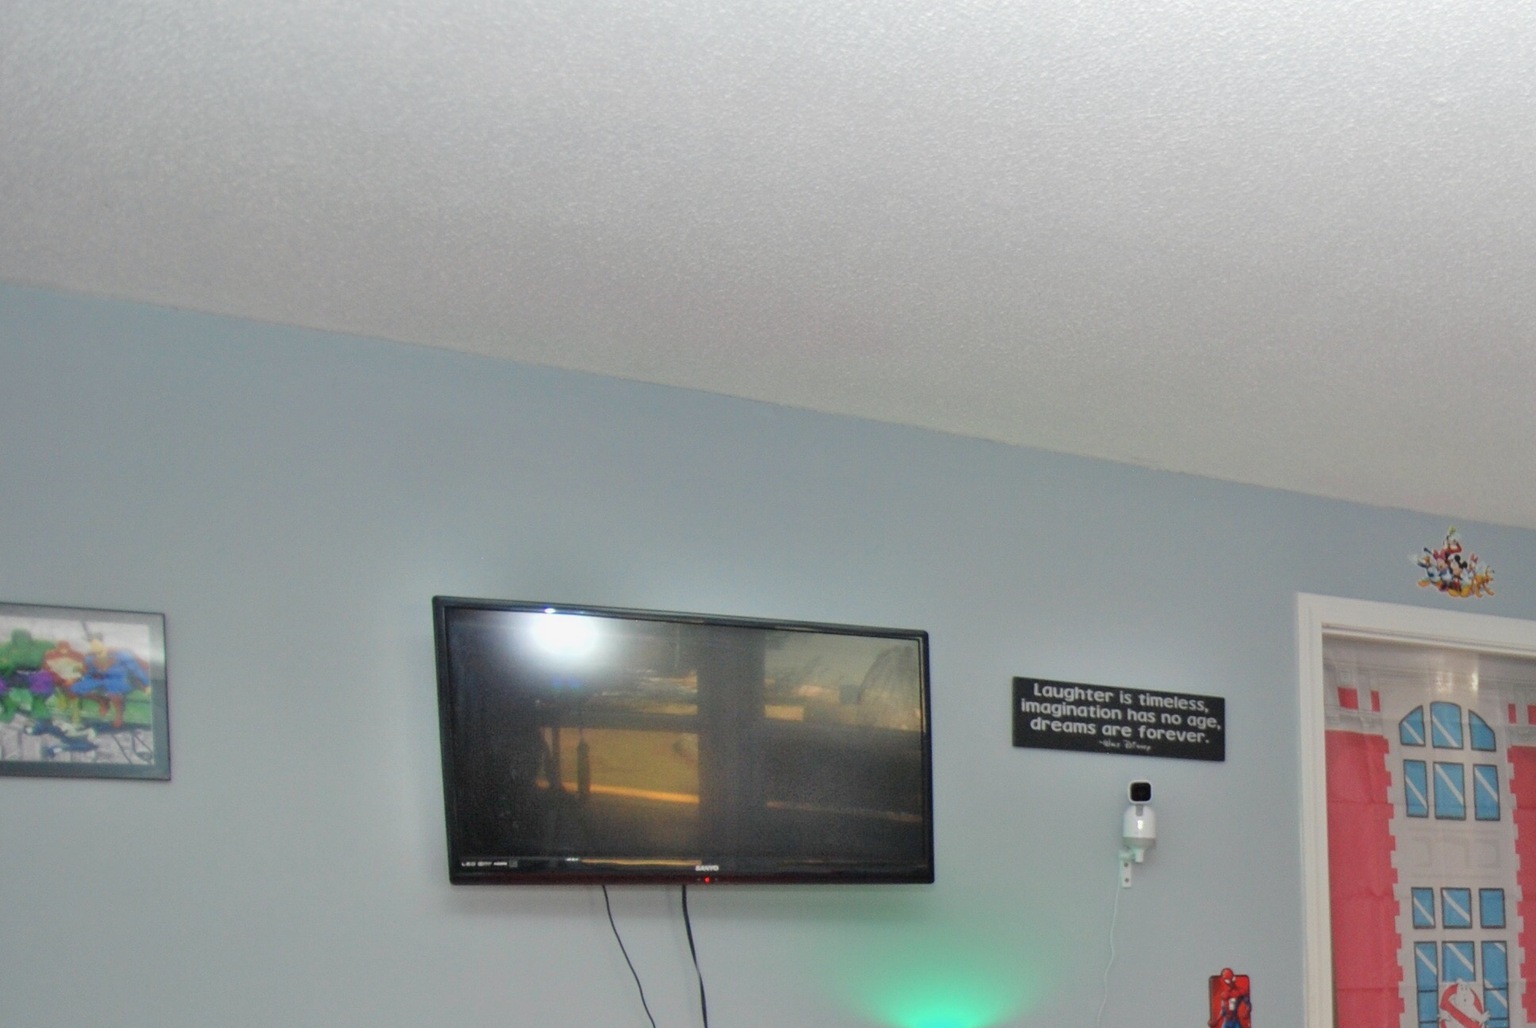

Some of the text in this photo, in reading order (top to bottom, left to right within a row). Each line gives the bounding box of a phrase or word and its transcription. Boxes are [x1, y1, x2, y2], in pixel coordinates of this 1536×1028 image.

[1033, 683, 1209, 714] Laughter is timeless,
[1021, 699, 1221, 730] imagination has no age,
[1030, 717, 1210, 744] dreams are forever.
